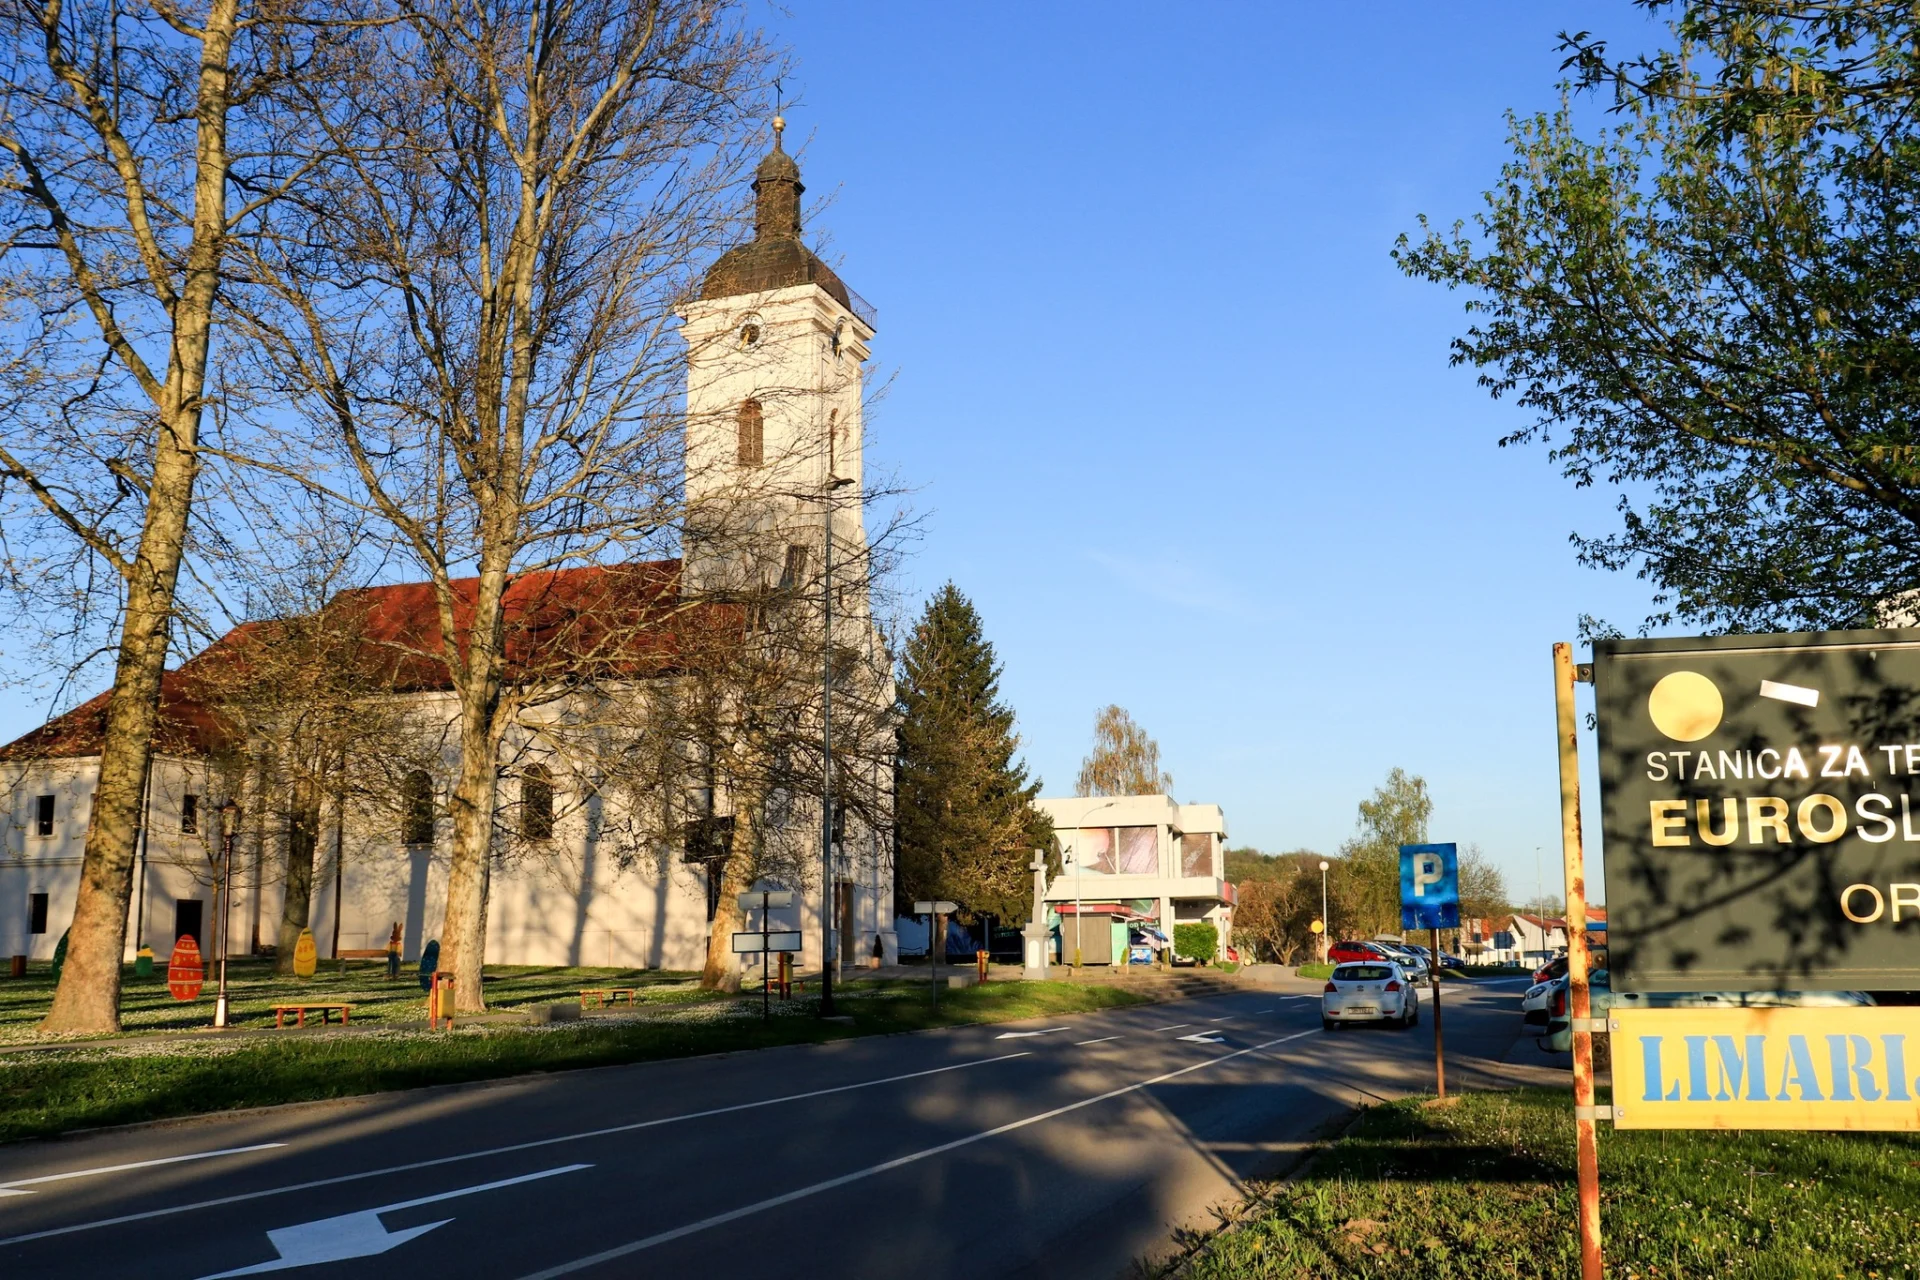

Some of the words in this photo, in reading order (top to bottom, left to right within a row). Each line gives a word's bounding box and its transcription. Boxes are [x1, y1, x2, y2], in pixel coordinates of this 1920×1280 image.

[1646, 747, 1809, 782] STANICA
[1818, 745, 1870, 778] ZA
[1413, 853, 1443, 897] P
[1840, 883, 1920, 924] OR
[1638, 1034, 1920, 1102] LIMARI
